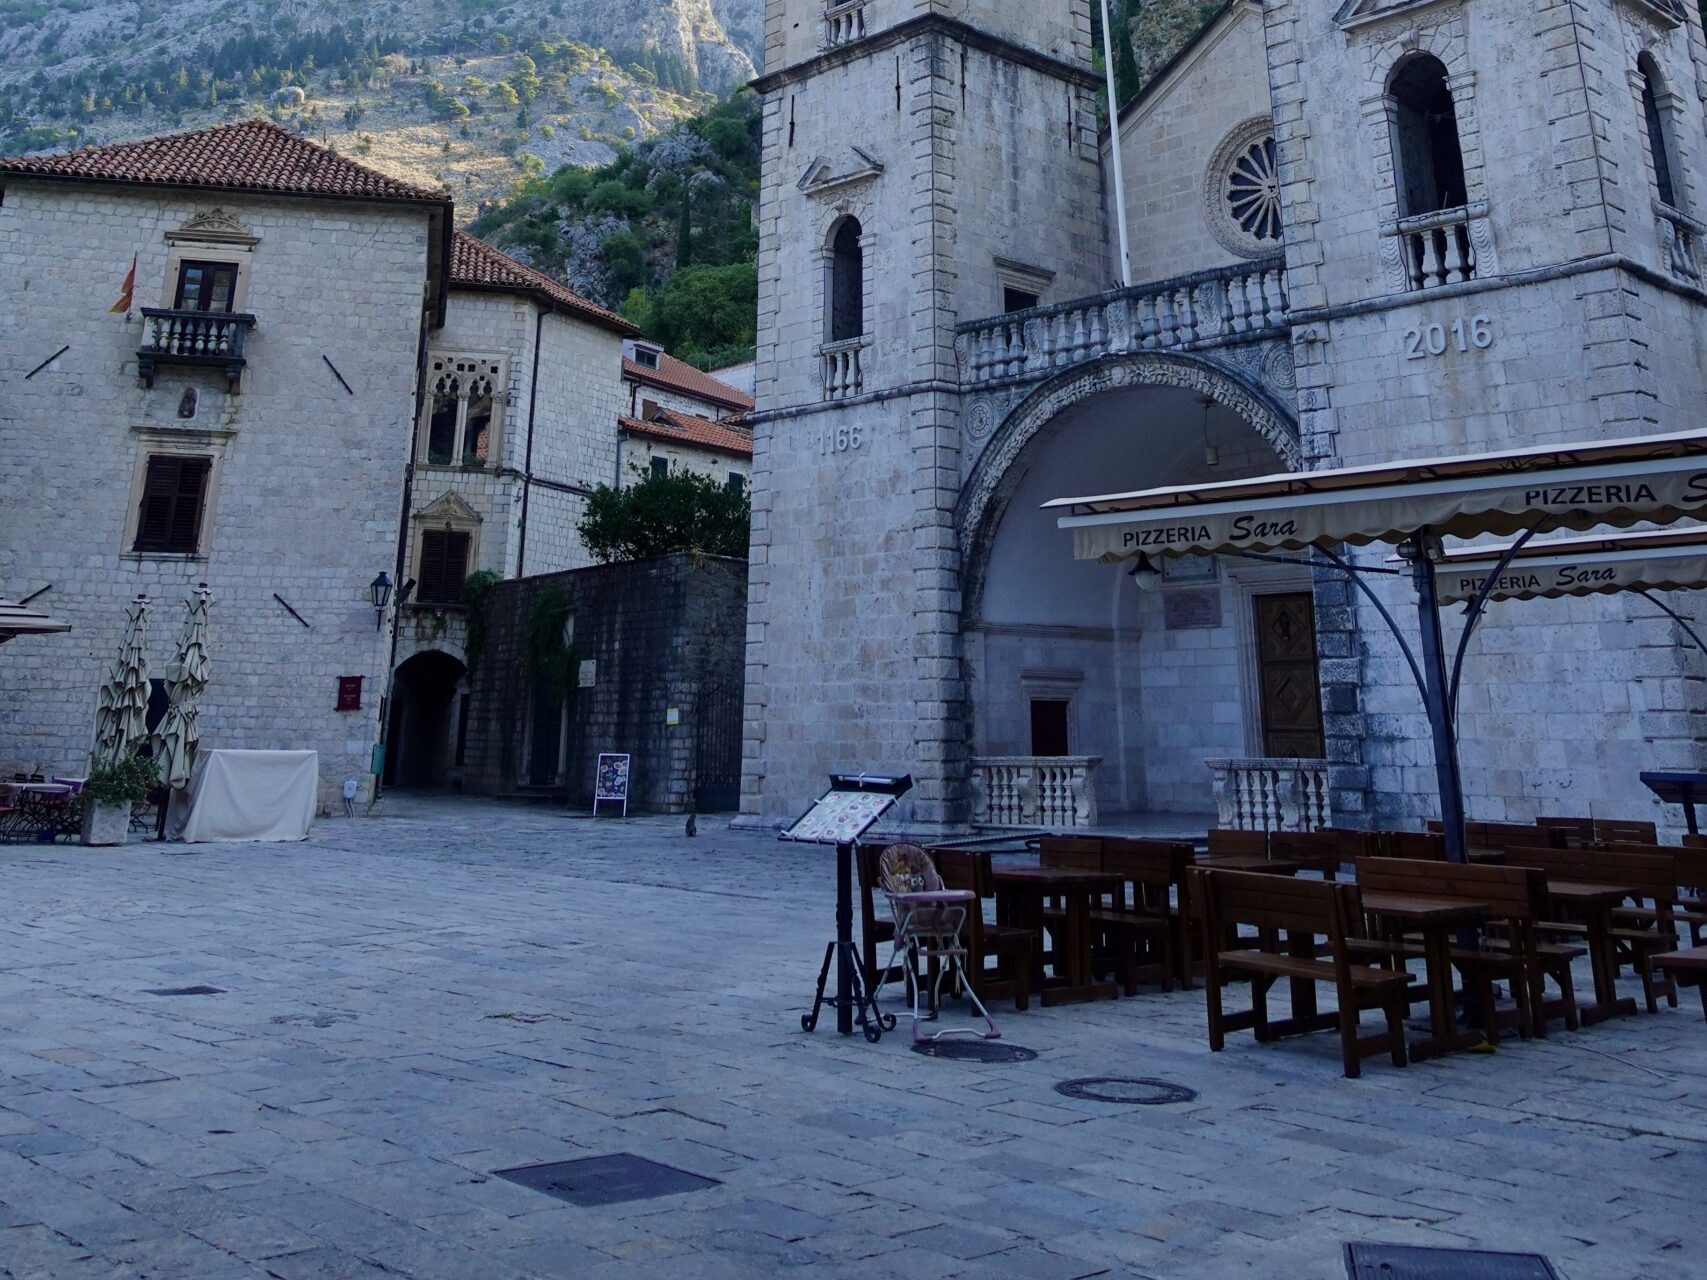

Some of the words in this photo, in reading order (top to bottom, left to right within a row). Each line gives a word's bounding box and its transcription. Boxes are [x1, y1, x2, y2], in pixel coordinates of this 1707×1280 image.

[1403, 313, 1493, 360] 2016
[817, 422, 863, 455] 1166
[1525, 484, 1657, 506] PIZZERIA
[1123, 525, 1212, 548] PIZZERIA
[1229, 515, 1298, 541] Sara
[1460, 574, 1541, 592] PIZERIA
[1556, 565, 1617, 587] Sara
